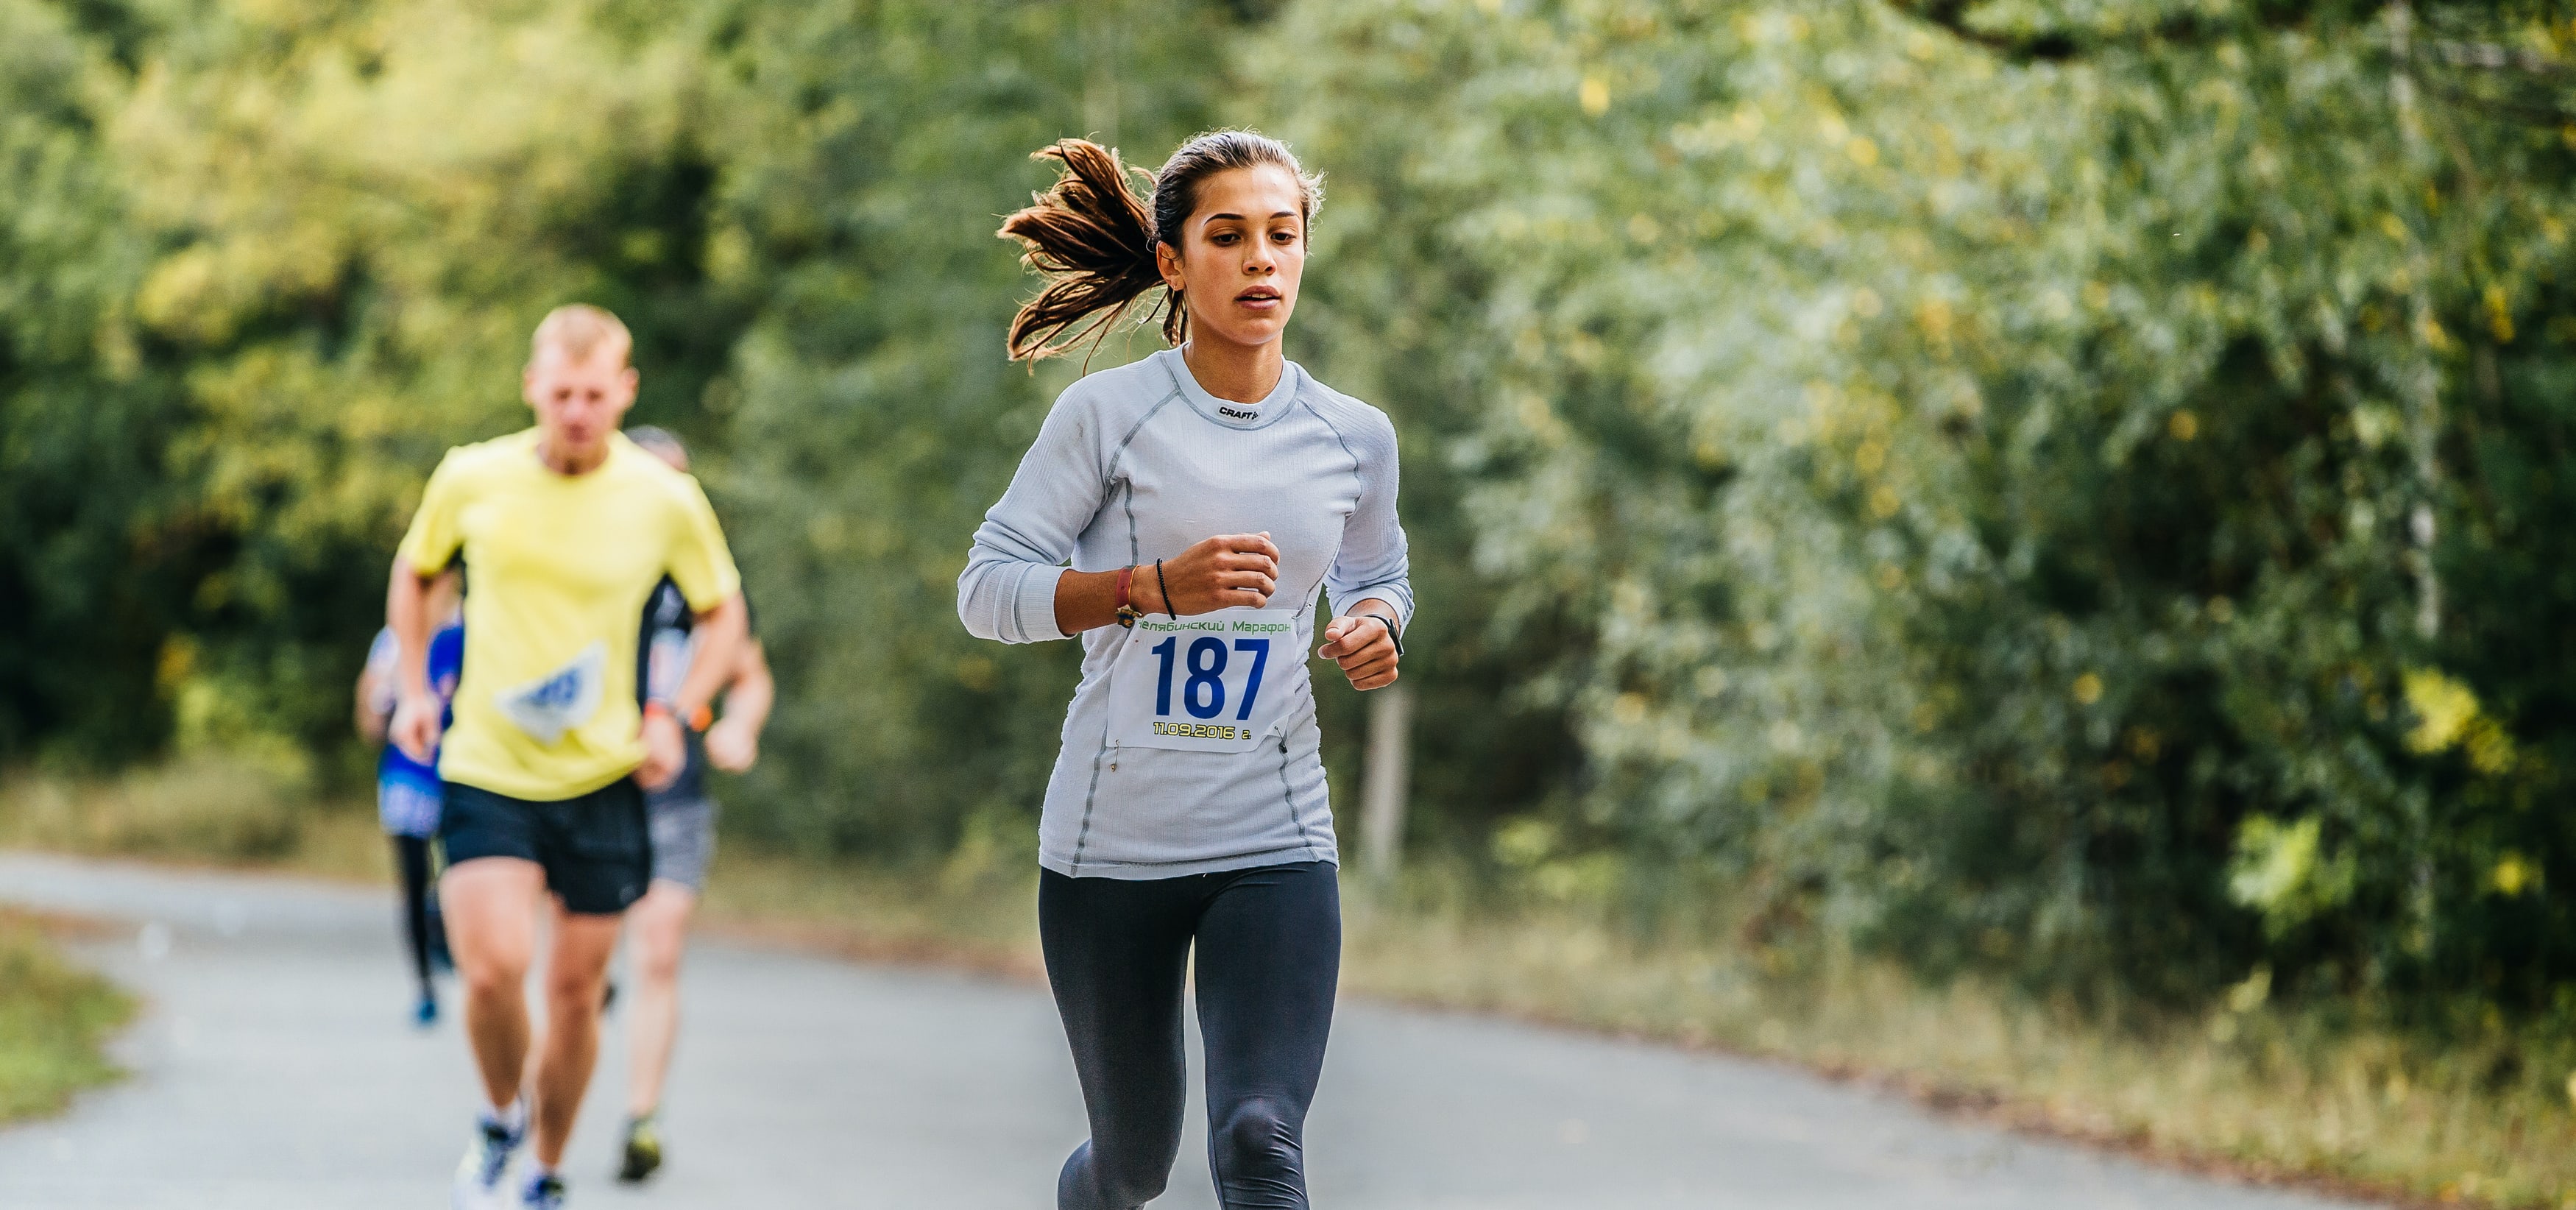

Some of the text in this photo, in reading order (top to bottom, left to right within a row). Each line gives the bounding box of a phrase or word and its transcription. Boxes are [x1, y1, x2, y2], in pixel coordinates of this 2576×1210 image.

[1219, 406, 1253, 419] CRAFT
[1232, 621, 1291, 635] Марафон
[1151, 636, 1270, 721] 187
[1153, 722, 1236, 739] 11.09.2016
